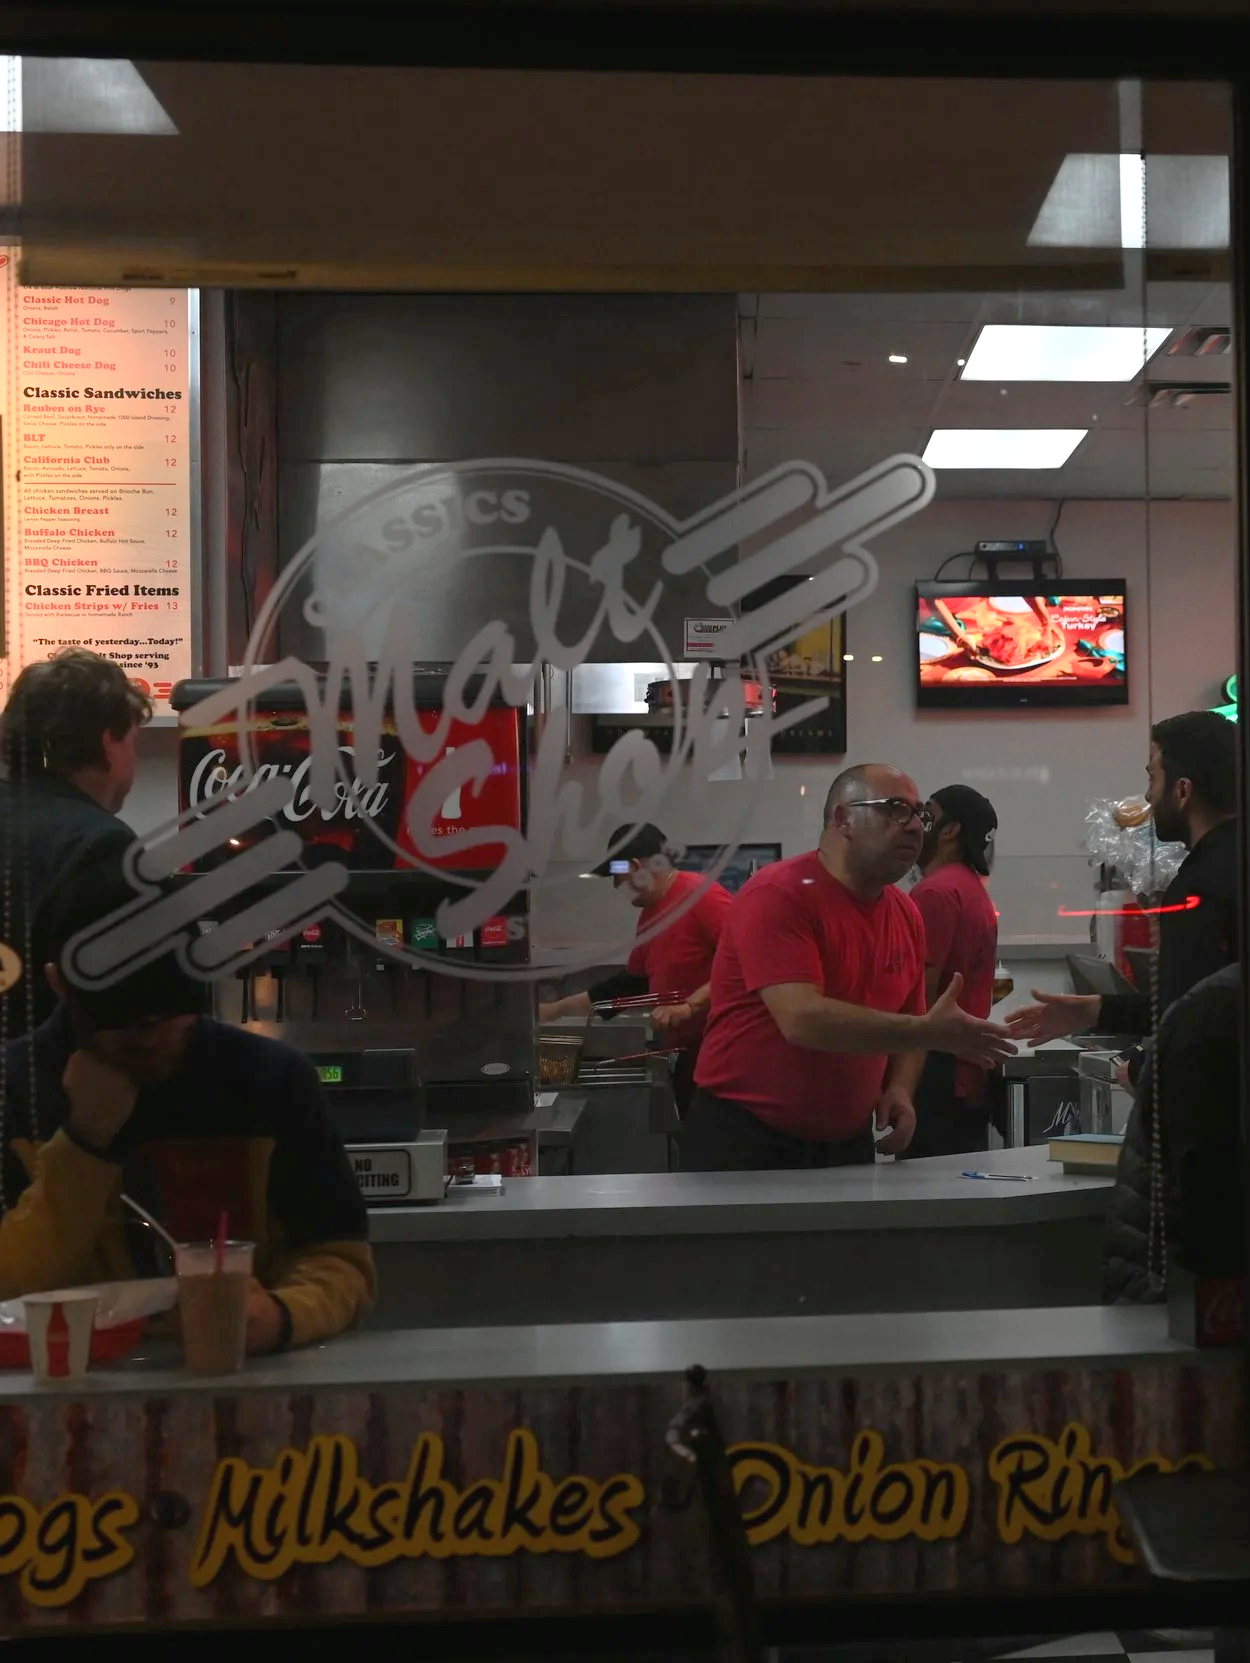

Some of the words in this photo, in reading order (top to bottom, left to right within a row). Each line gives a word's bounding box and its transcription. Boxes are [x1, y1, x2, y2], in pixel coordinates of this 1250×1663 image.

[23, 296, 61, 304] Classic
[64, 296, 84, 304] Hot
[88, 296, 110, 306] Dog
[170, 297, 175, 305] 9
[23, 318, 67, 327] Chicago
[70, 318, 90, 326] Hot
[94, 318, 115, 327] Dog
[164, 320, 176, 328] 10
[23, 346, 56, 354] Kraut
[60, 346, 82, 356] Dog
[164, 349, 176, 357] 10
[53, 361, 91, 369] Cheese
[94, 361, 116, 371] Dog
[164, 363, 176, 372] 10
[23, 387, 80, 399] Classic
[84, 387, 182, 399] Sandwiches
[23, 404, 65, 412] Reuben
[85, 405, 106, 414] Rye
[23, 434, 45, 442] BLT
[165, 435, 177, 443] 12
[24, 456, 80, 464] California
[84, 456, 110, 464] Club
[73, 507, 109, 515] Breast
[165, 508, 177, 516] 12
[25, 559, 49, 567] BBQ
[166, 560, 178, 568] 12
[25, 585, 82, 596] Classic
[86, 585, 129, 596] Fried
[133, 585, 179, 596] Items
[25, 602, 71, 610] Chicken
[75, 602, 109, 611] Strips
[112, 602, 127, 611] w/
[131, 602, 159, 610] Fries
[166, 602, 178, 610] 13
[1060, 621, 1097, 631] Turkey
[109, 652, 133, 660] Shop
[354, 1158, 372, 1172] NO
[359, 1173, 400, 1188] CITING
[724, 1427, 973, 1544] Onion
[988, 1420, 1218, 1568] Rin
[189, 1427, 647, 1587] Milkshakes
